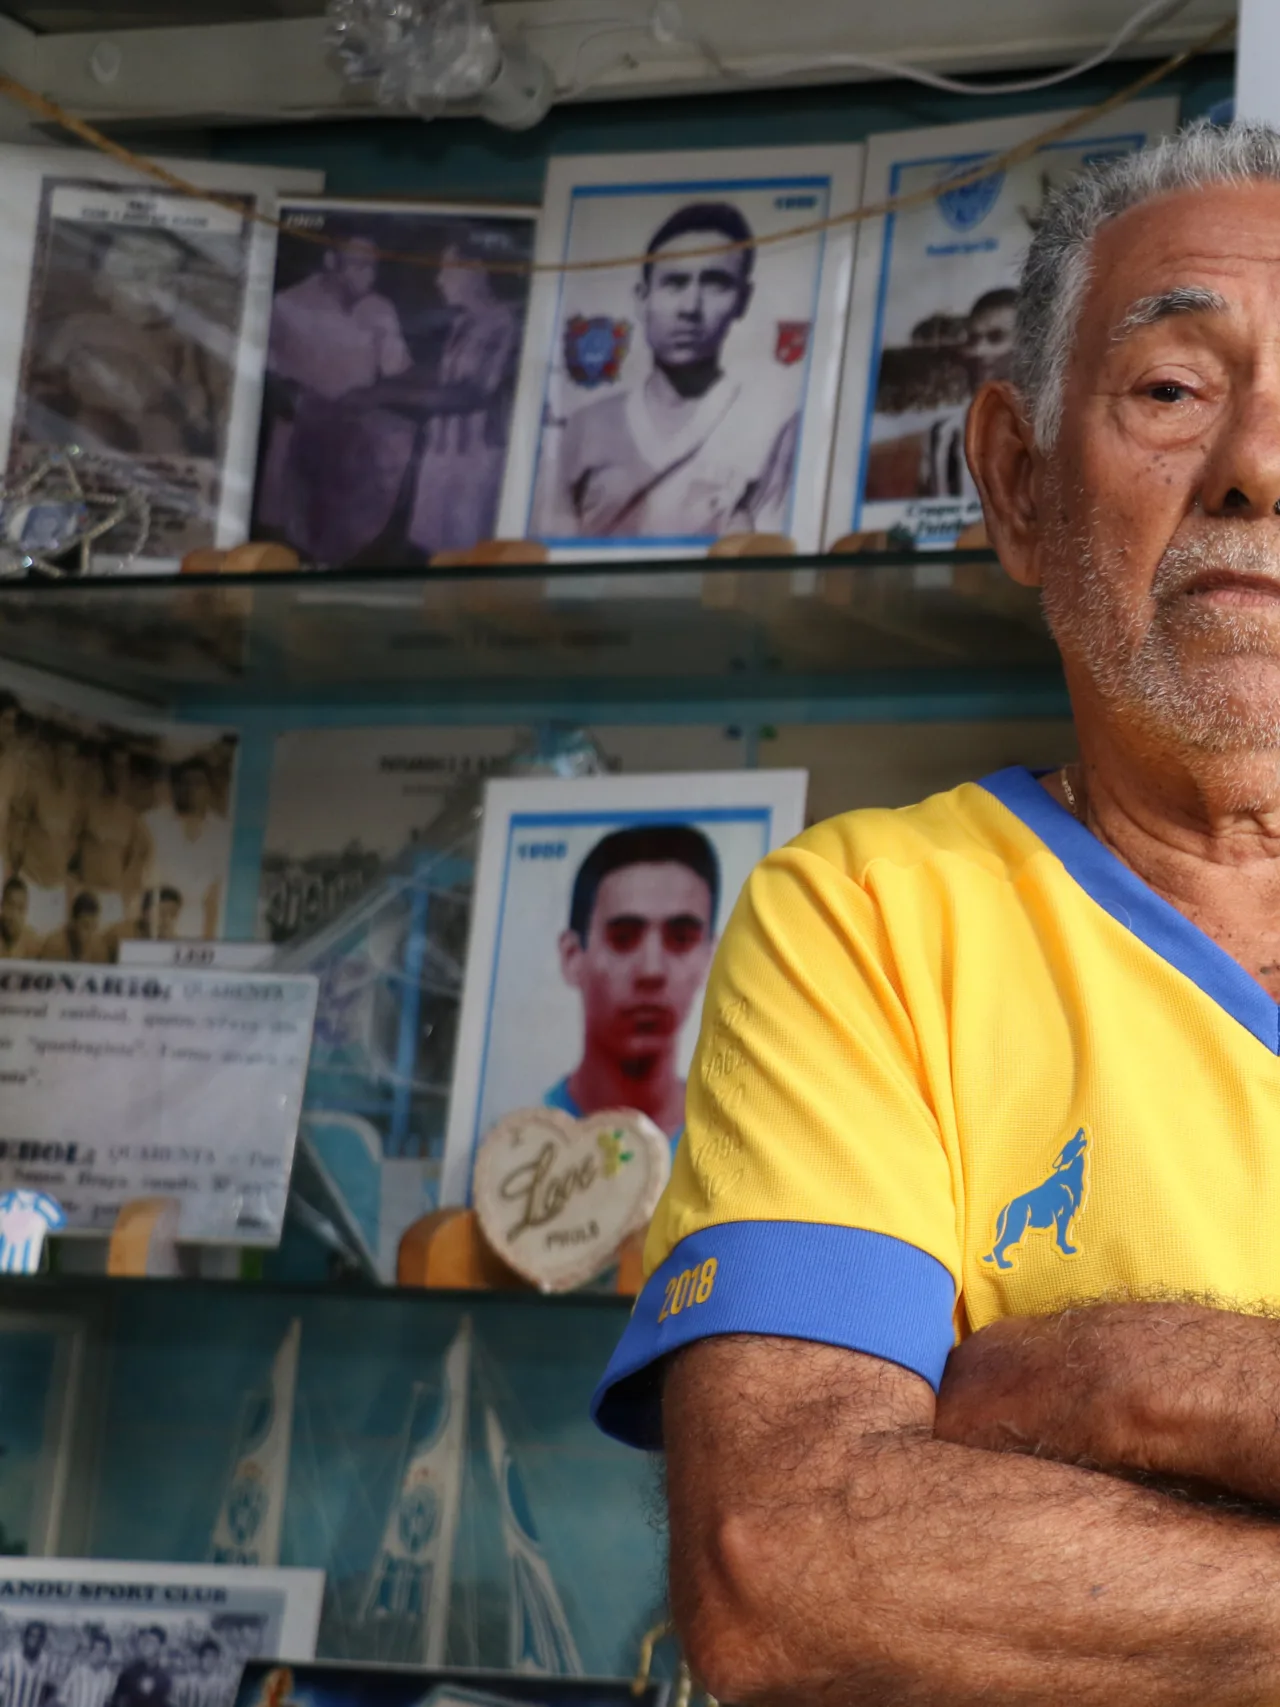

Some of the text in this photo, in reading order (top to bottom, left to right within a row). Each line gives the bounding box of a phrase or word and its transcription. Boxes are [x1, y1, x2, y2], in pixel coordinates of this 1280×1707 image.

[499, 1140, 599, 1243] Love
[658, 1257, 717, 1323] 2018
[79, 1582, 155, 1602] SPORT
[164, 1585, 228, 1604] CLUB
